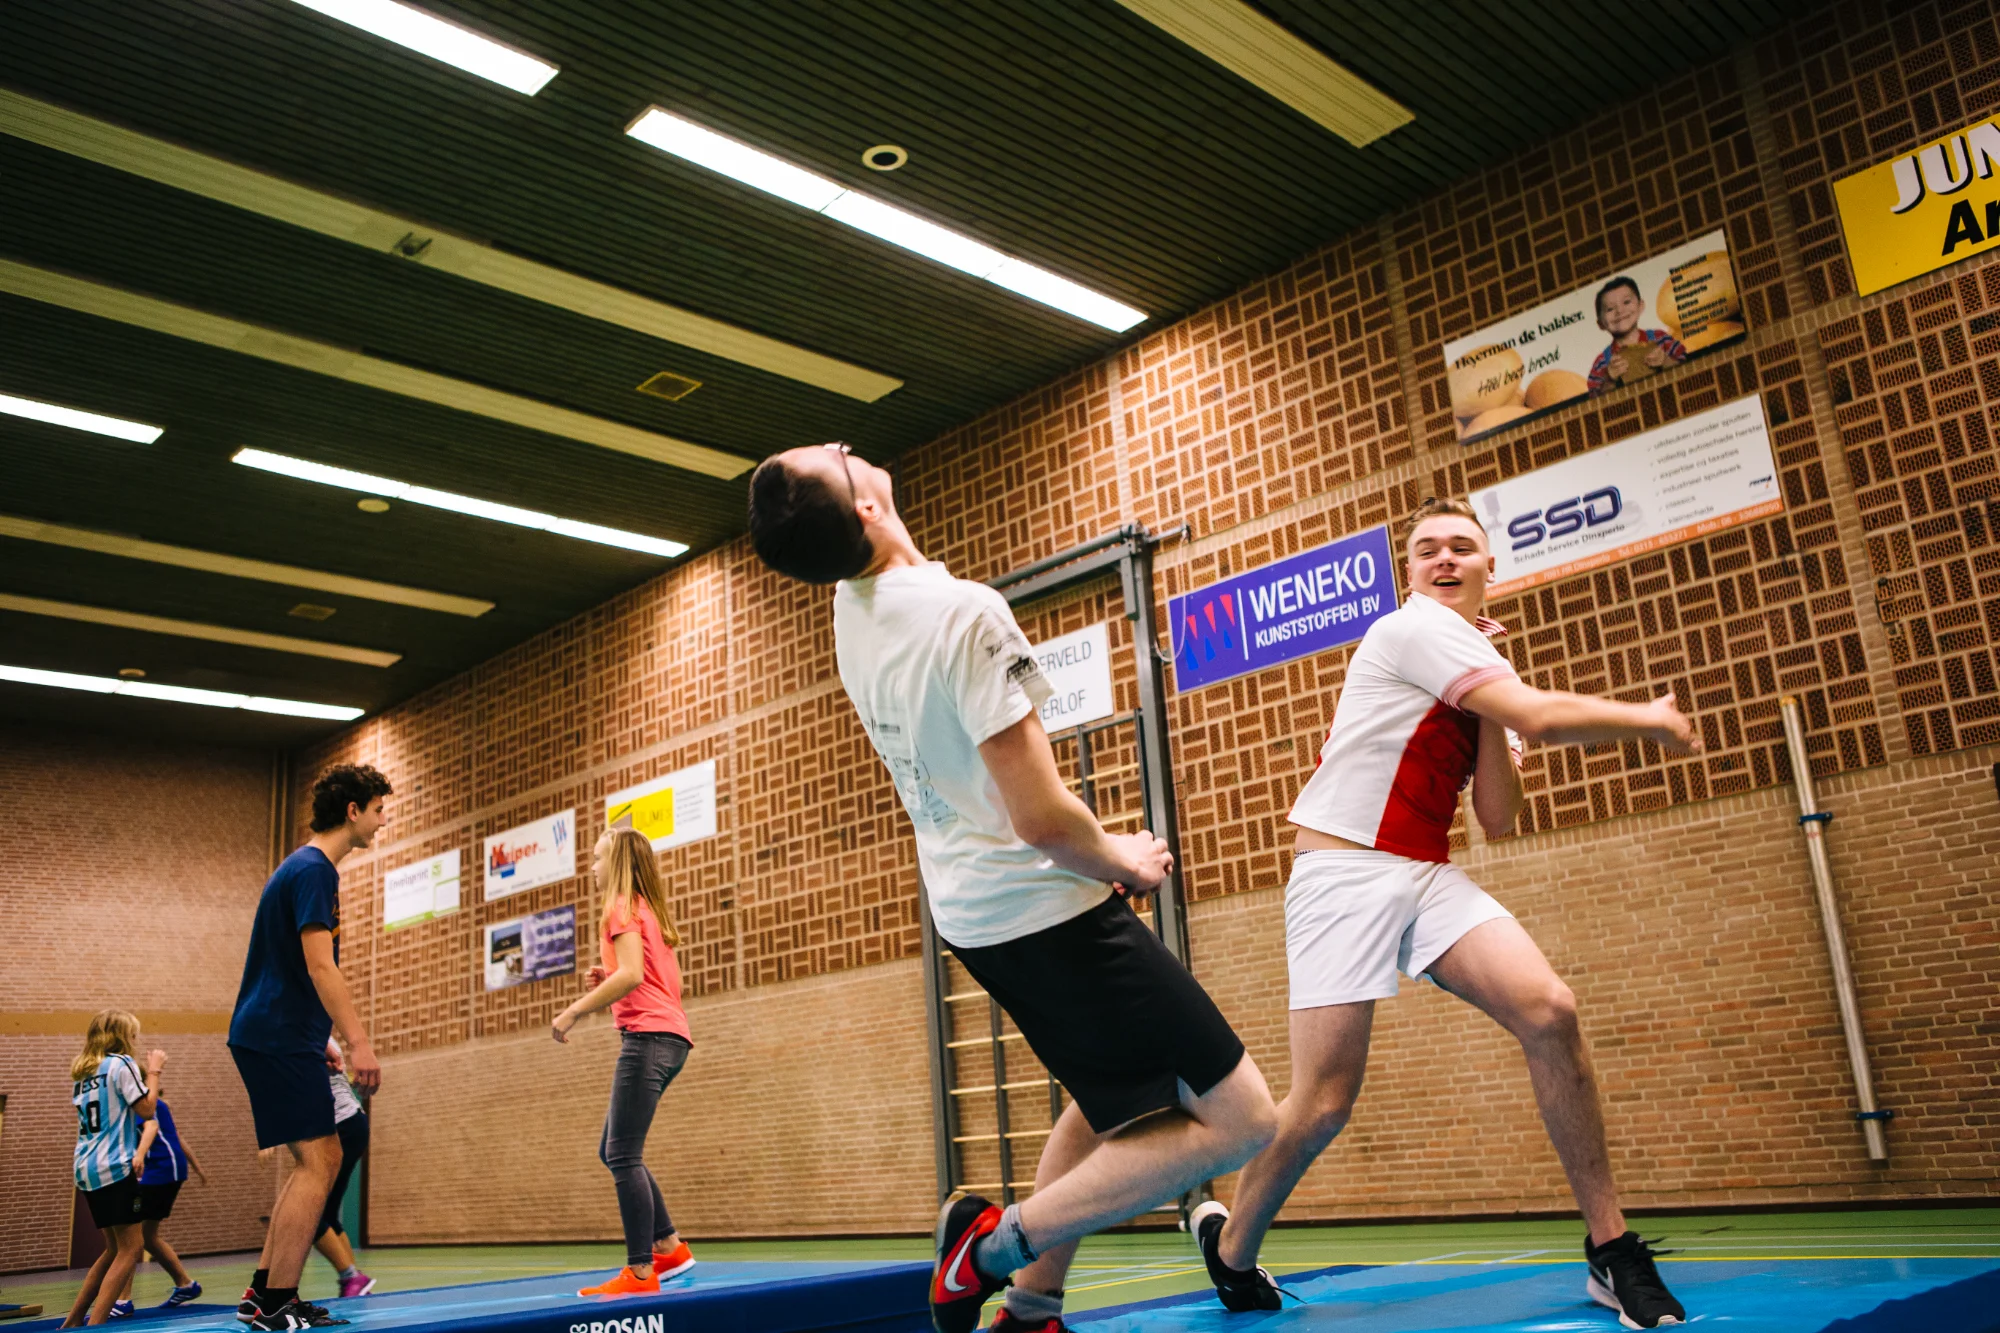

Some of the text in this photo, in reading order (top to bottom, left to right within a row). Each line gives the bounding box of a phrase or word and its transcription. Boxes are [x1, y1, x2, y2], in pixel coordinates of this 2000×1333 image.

[1518, 329, 1536, 345] de
[1693, 423, 1719, 436] zonder
[1507, 485, 1623, 552] SSD
[1514, 524, 1625, 565] Schade Service Dinxperlo
[1249, 551, 1375, 622] WENEKO
[1255, 593, 1380, 649] KUNSTSTOFFEN BV
[1039, 689, 1086, 720] ERLOF
